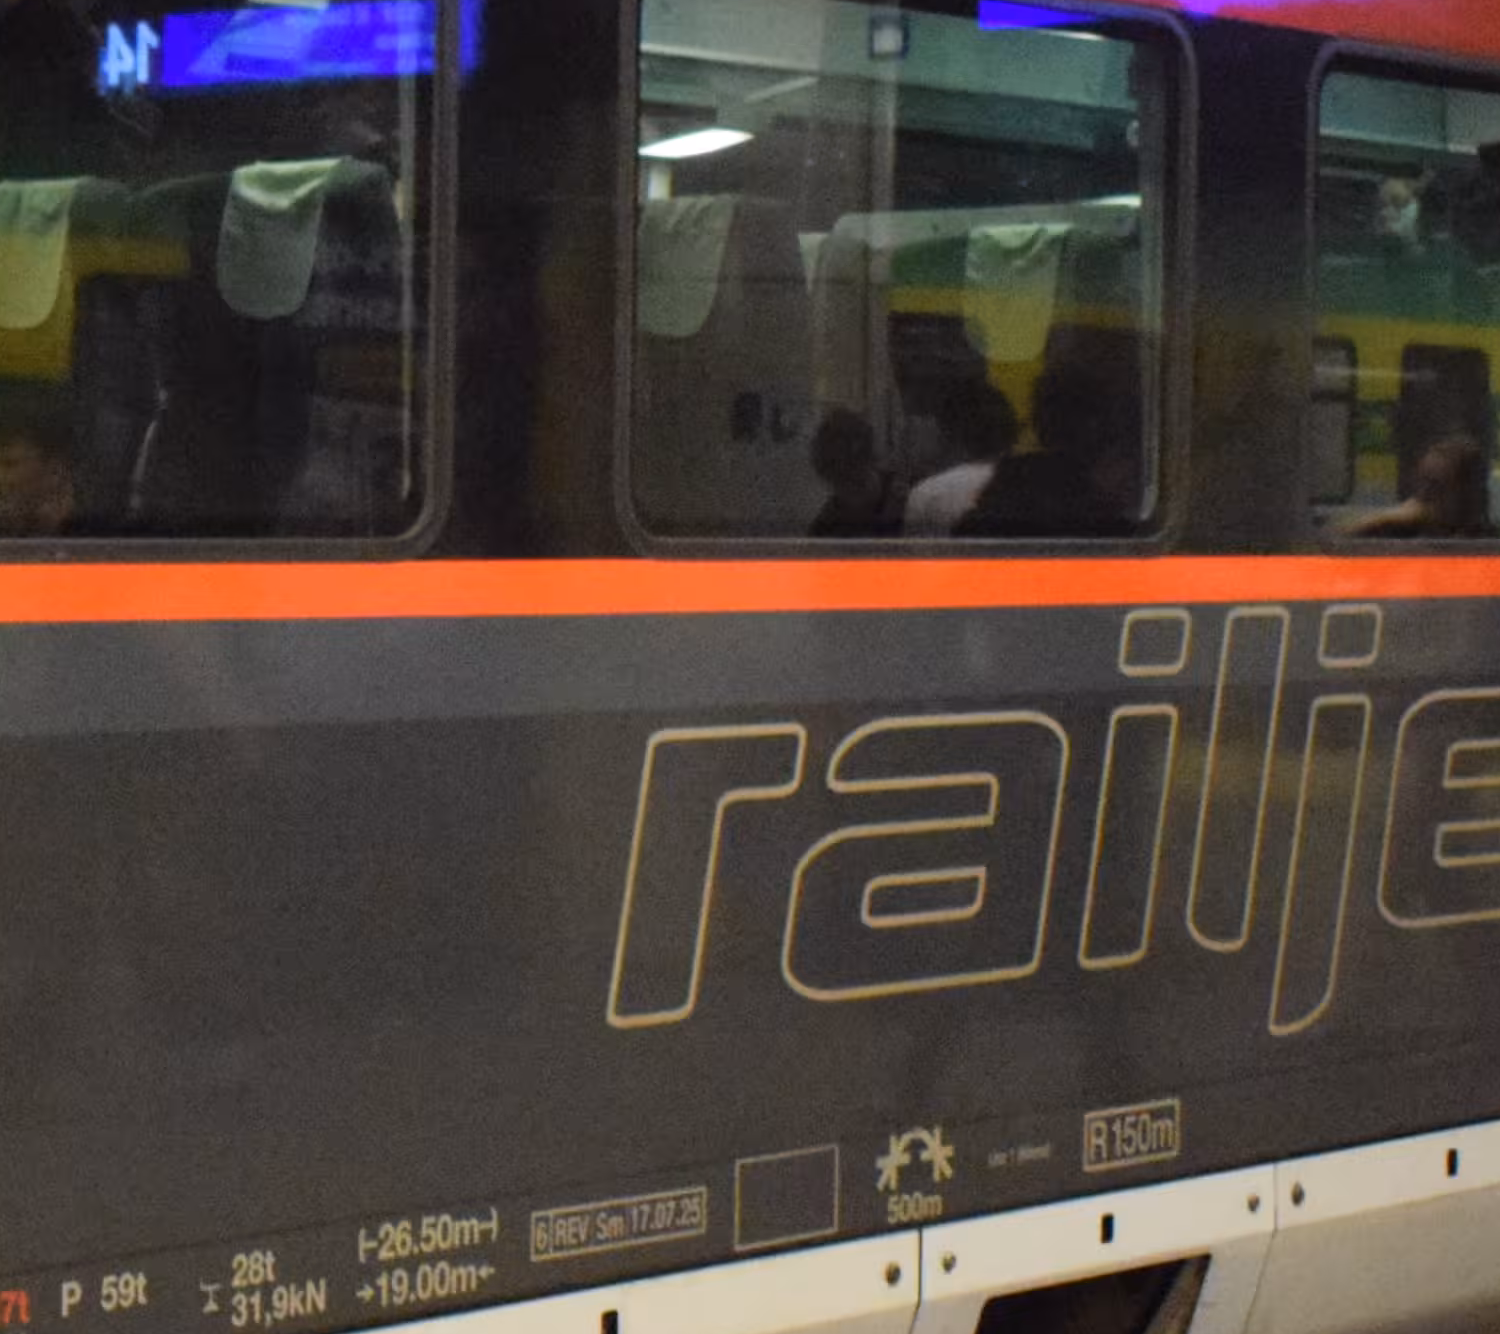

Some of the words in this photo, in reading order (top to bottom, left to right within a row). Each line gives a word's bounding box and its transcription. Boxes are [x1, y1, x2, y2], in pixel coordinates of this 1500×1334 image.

[1090, 1121, 1108, 1160] R
[1112, 1113, 1175, 1155] 150m
[888, 1192, 943, 1224] 500m
[555, 1217, 590, 1247] REV
[231, 1250, 276, 1288] 28t
[61, 1280, 83, 1318] P
[100, 1271, 148, 1312] 59t
[231, 1277, 327, 1328] 31,9kN
